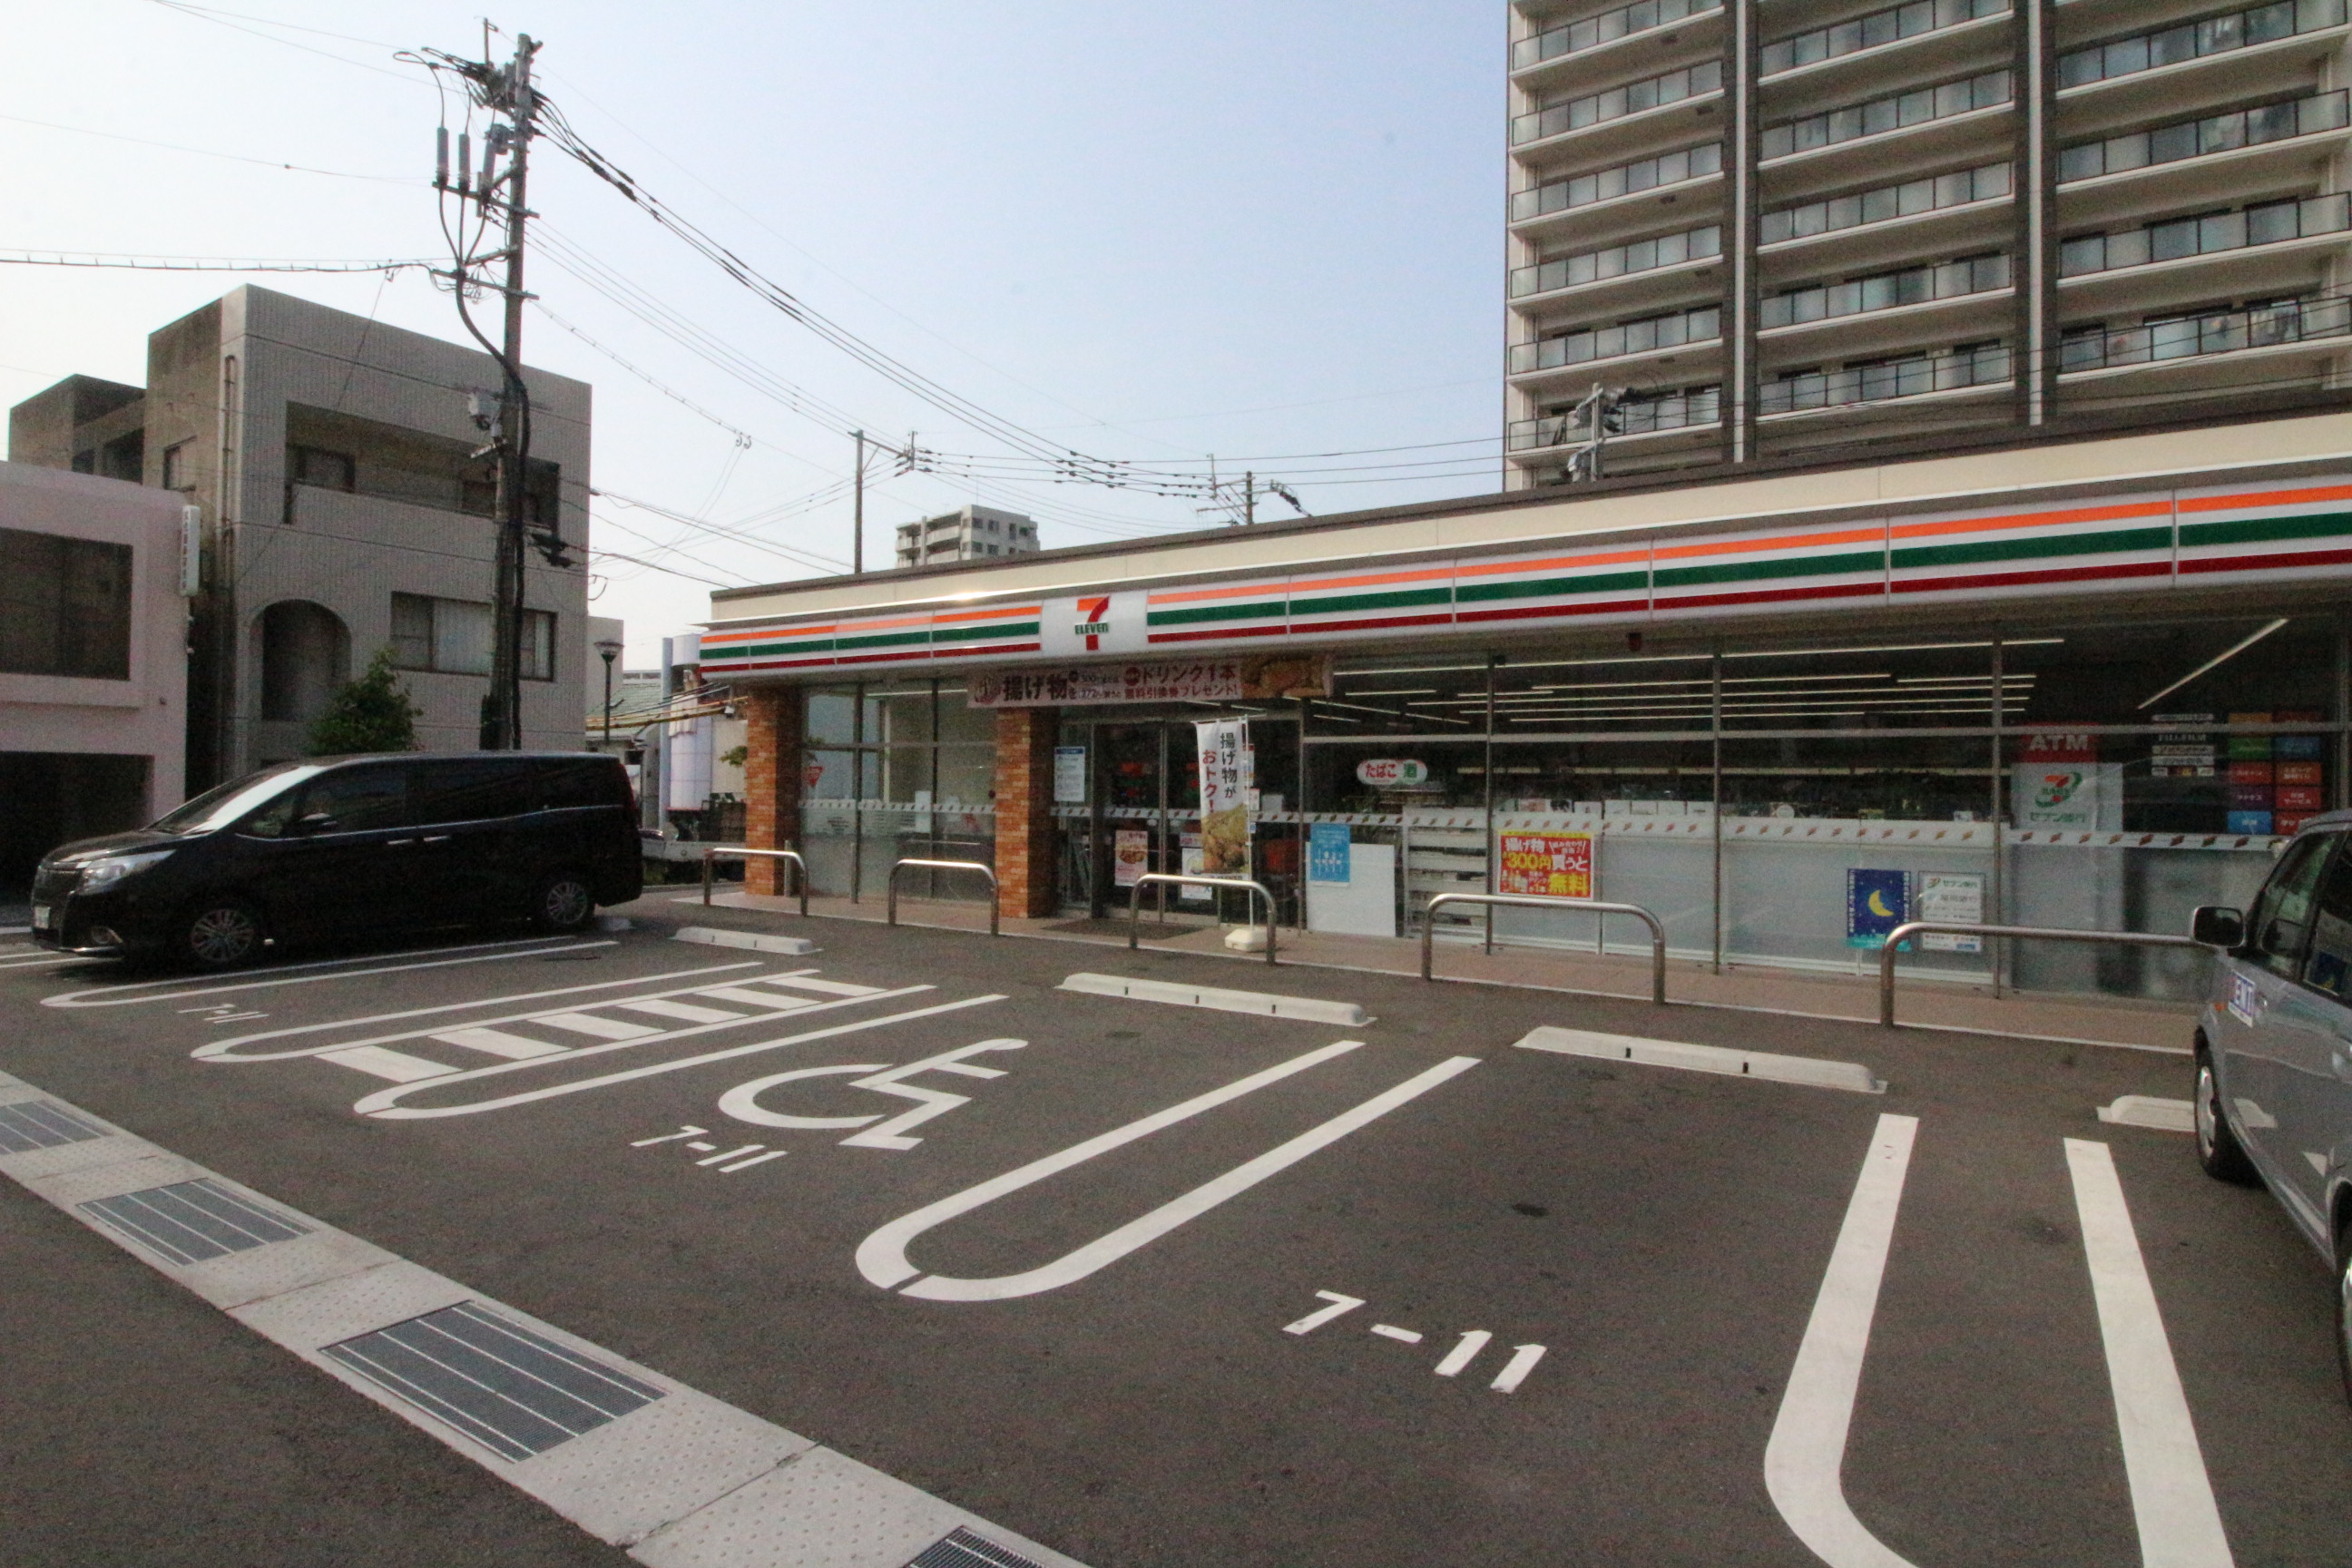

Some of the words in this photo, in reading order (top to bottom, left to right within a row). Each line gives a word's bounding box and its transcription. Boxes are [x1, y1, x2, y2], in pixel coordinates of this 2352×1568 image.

[2028, 734, 2089, 751] ATM
[1220, 732, 1238, 799] 揚げ物が
[1366, 763, 1397, 779] たばこ
[1505, 838, 1545, 853] 揚げ物
[1548, 872, 1588, 896] 無料
[1281, 1289, 1548, 1395] 7-11
